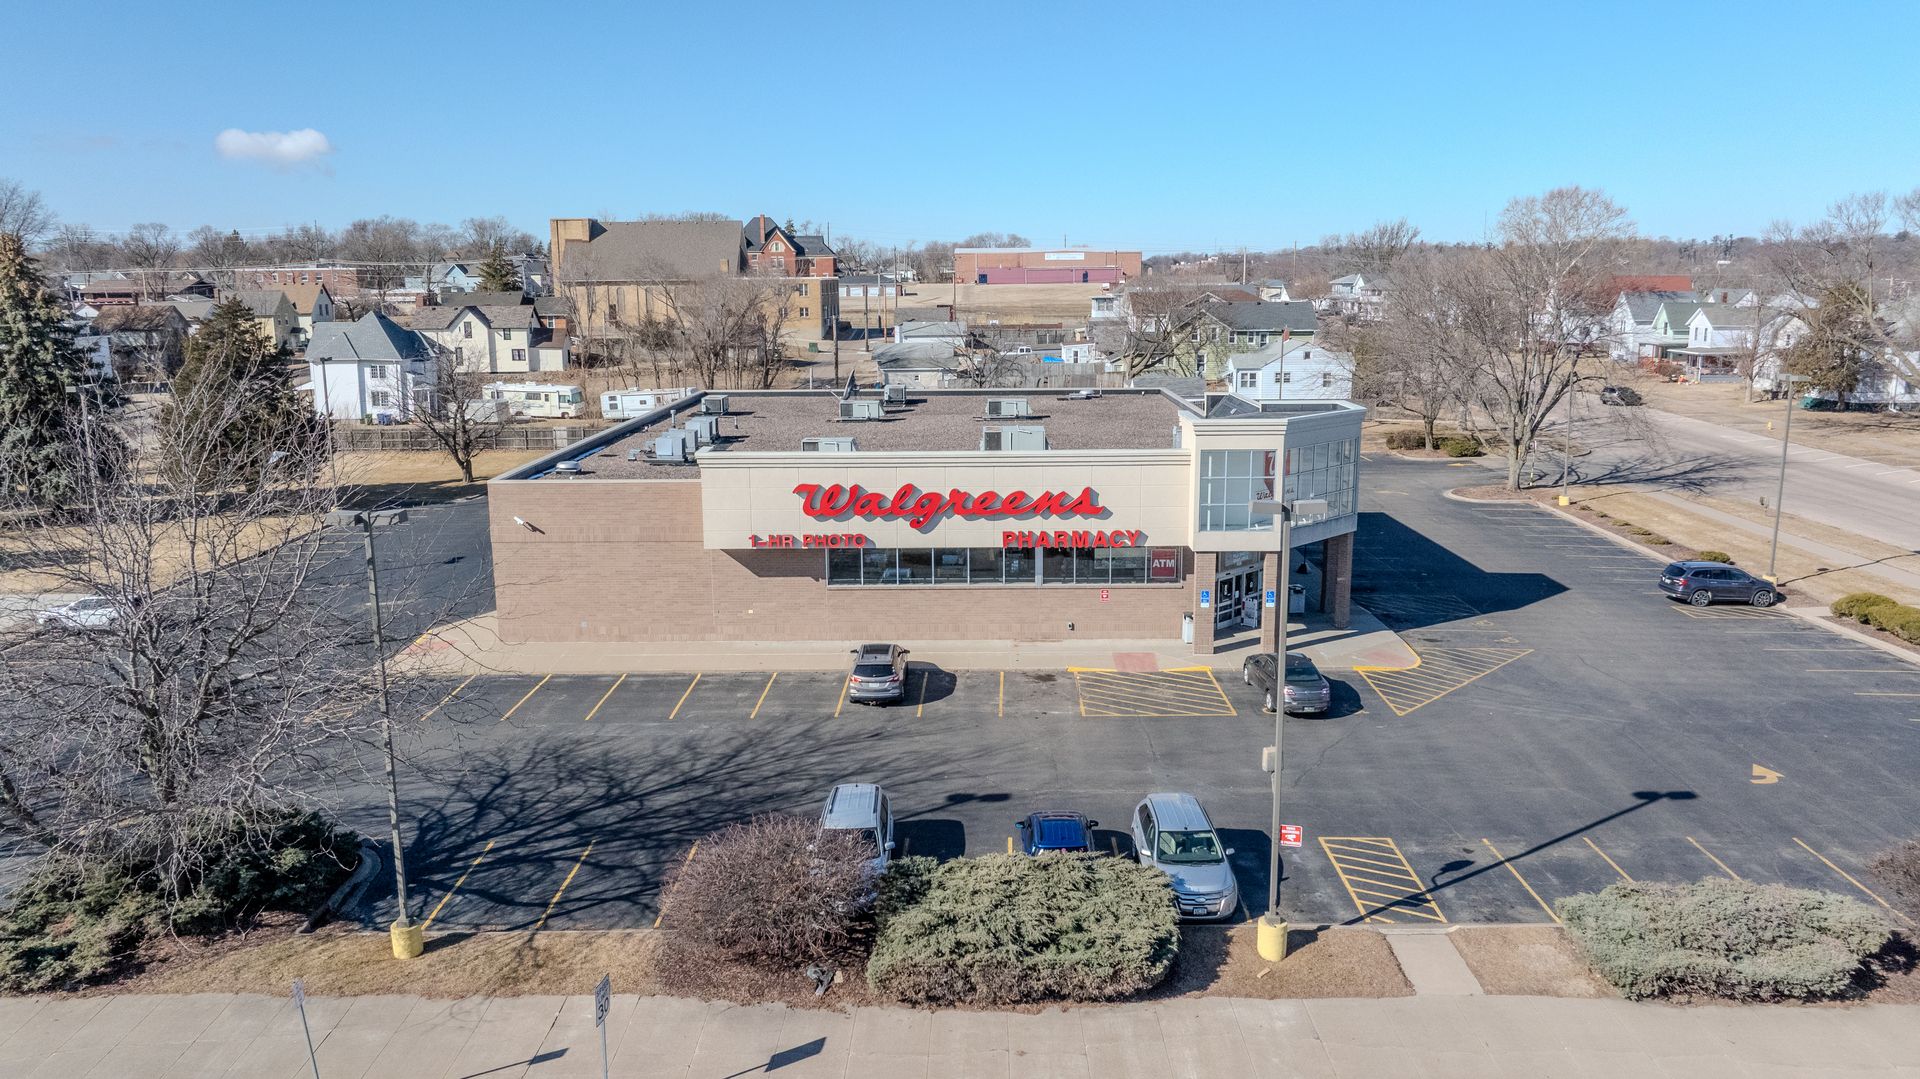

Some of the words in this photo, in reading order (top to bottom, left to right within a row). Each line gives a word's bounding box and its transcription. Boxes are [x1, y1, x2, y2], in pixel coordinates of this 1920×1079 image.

[793, 483, 1105, 529] Walgreens
[749, 534, 795, 549] 1-HR
[802, 533, 866, 549] PHOTO
[1002, 530, 1140, 549] PHARMACY
[1153, 559, 1175, 568] ATM
[598, 997, 609, 1020] 30
